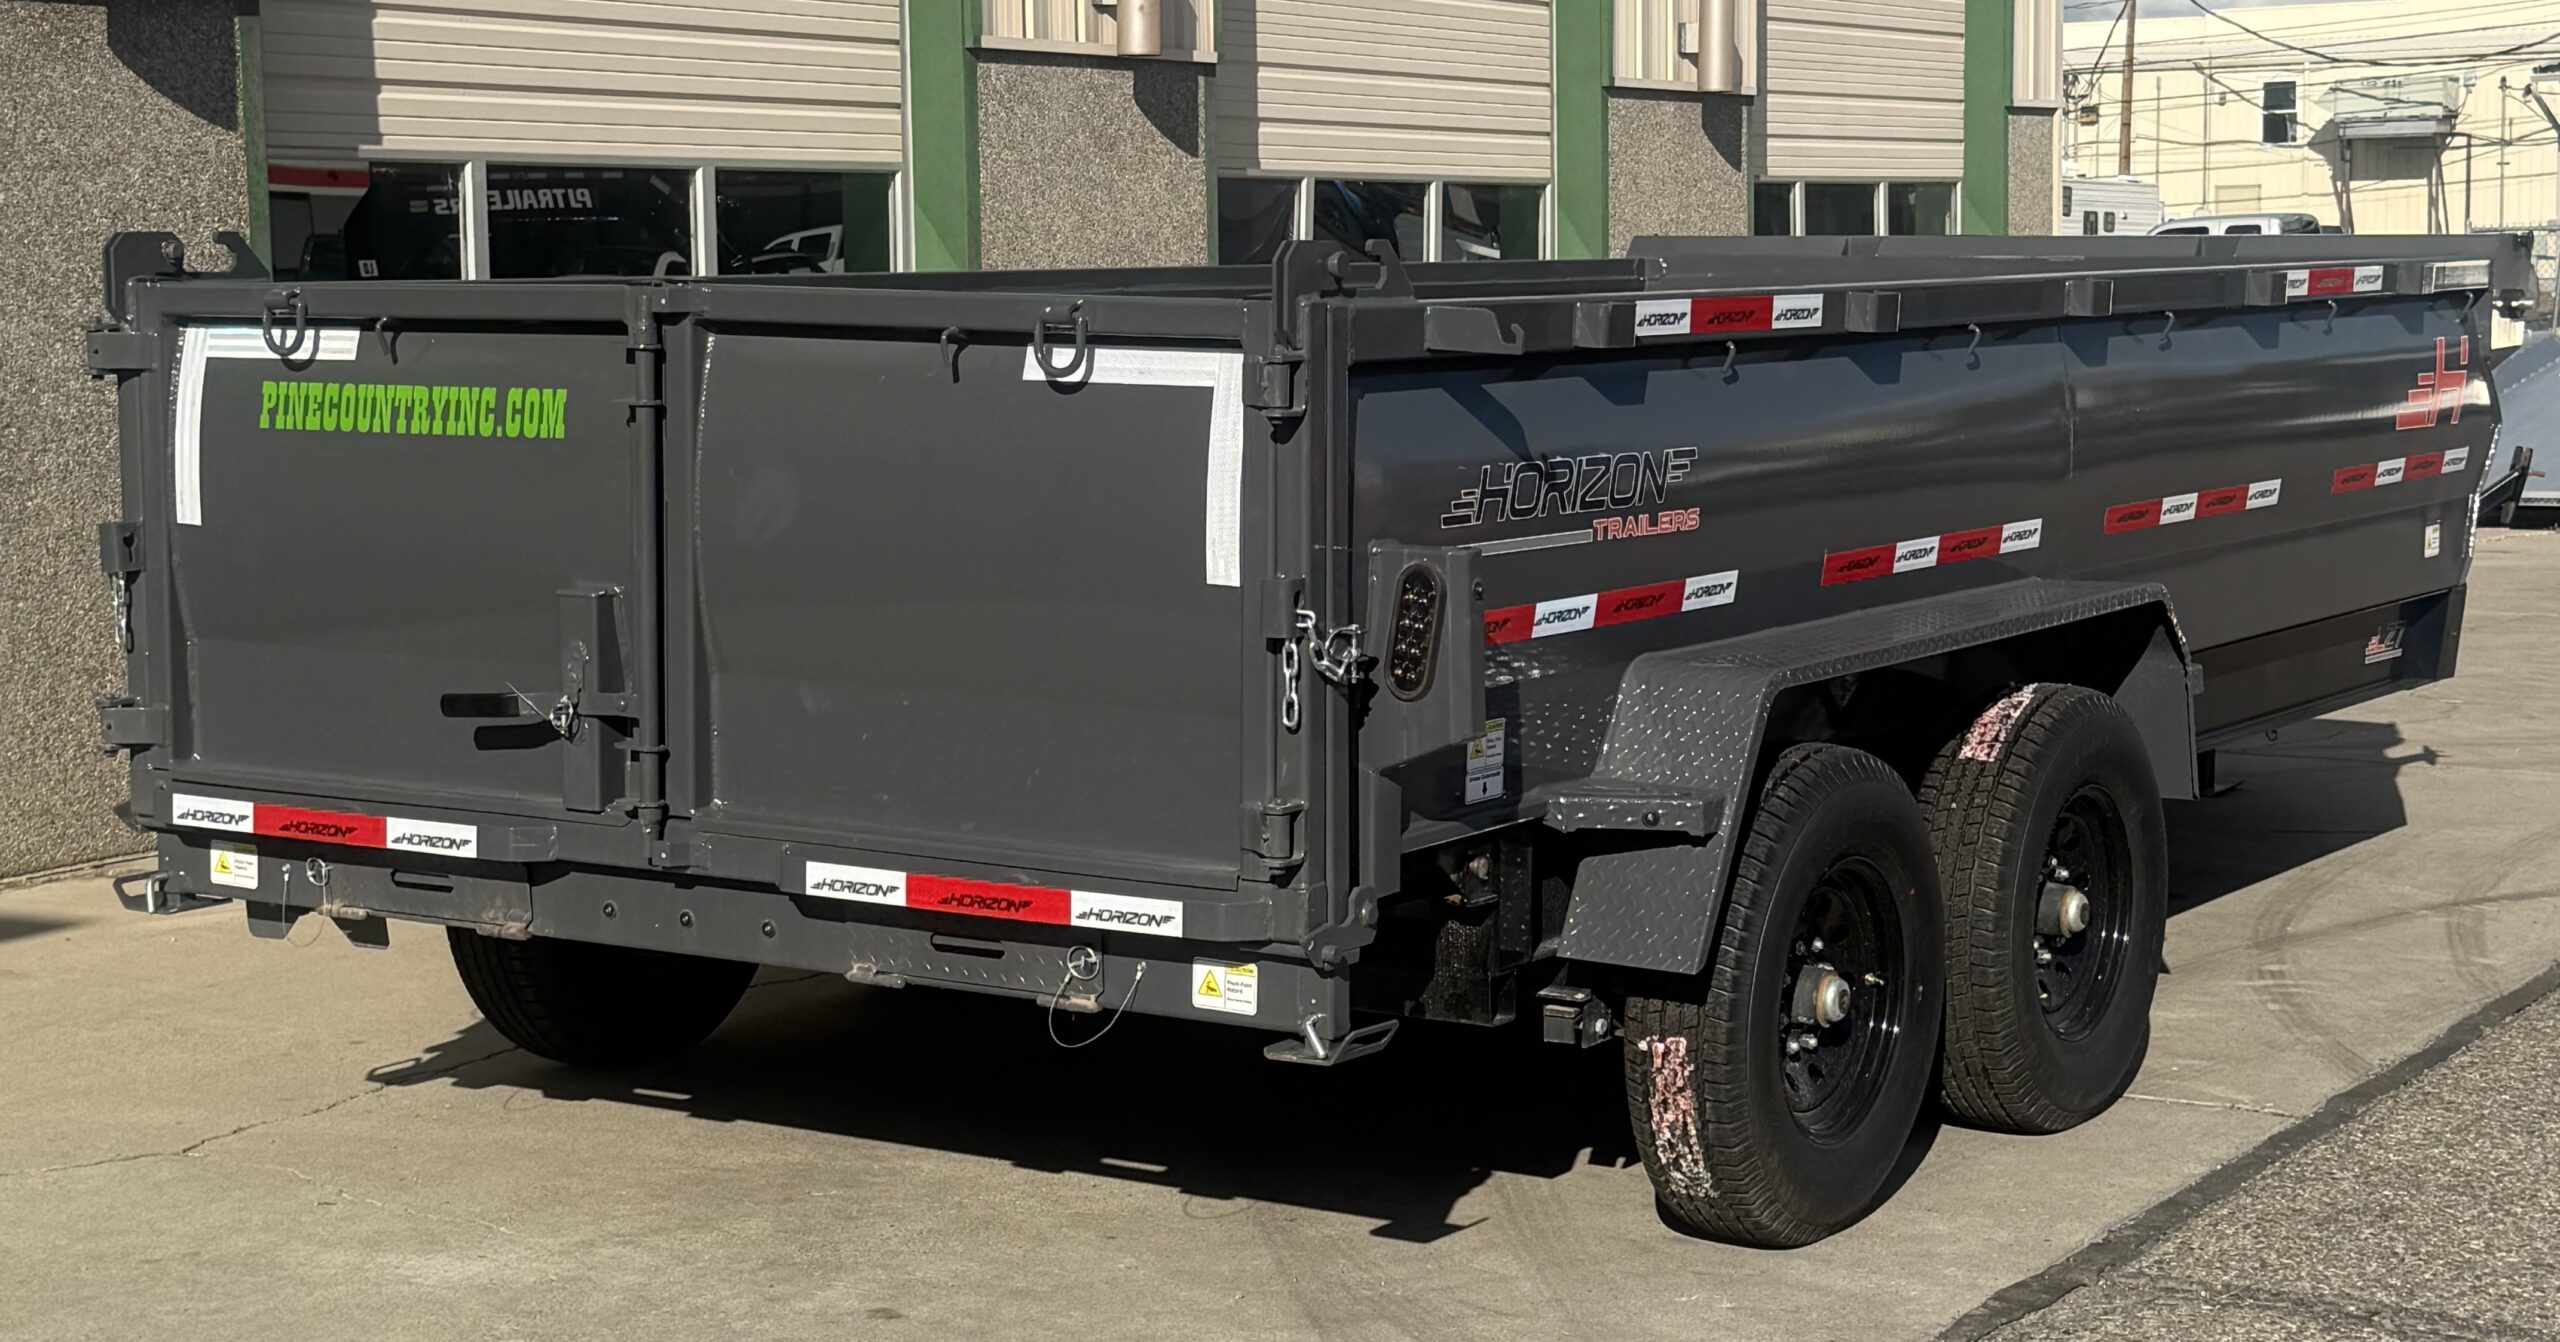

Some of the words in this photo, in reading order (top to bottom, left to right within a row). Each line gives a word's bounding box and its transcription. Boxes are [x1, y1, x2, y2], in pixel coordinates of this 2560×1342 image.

[1640, 312, 1685, 327] HORIZON
[1778, 307, 1817, 322] HORIZON
[259, 381, 568, 439] PINECOUNTRYINC.COM
[1473, 449, 1672, 525] HORIZON
[1593, 508, 1700, 541] TRAILERS
[1539, 606, 1587, 626] HORIZON
[1689, 582, 1731, 600] HORIZON
[184, 808, 242, 826] HORIZON
[288, 819, 349, 838] HORIZON
[400, 833, 464, 851] HORIZON
[820, 878, 890, 897] HORIZON
[947, 892, 1023, 913] HORIZON
[1086, 907, 1164, 928] HORIZON
